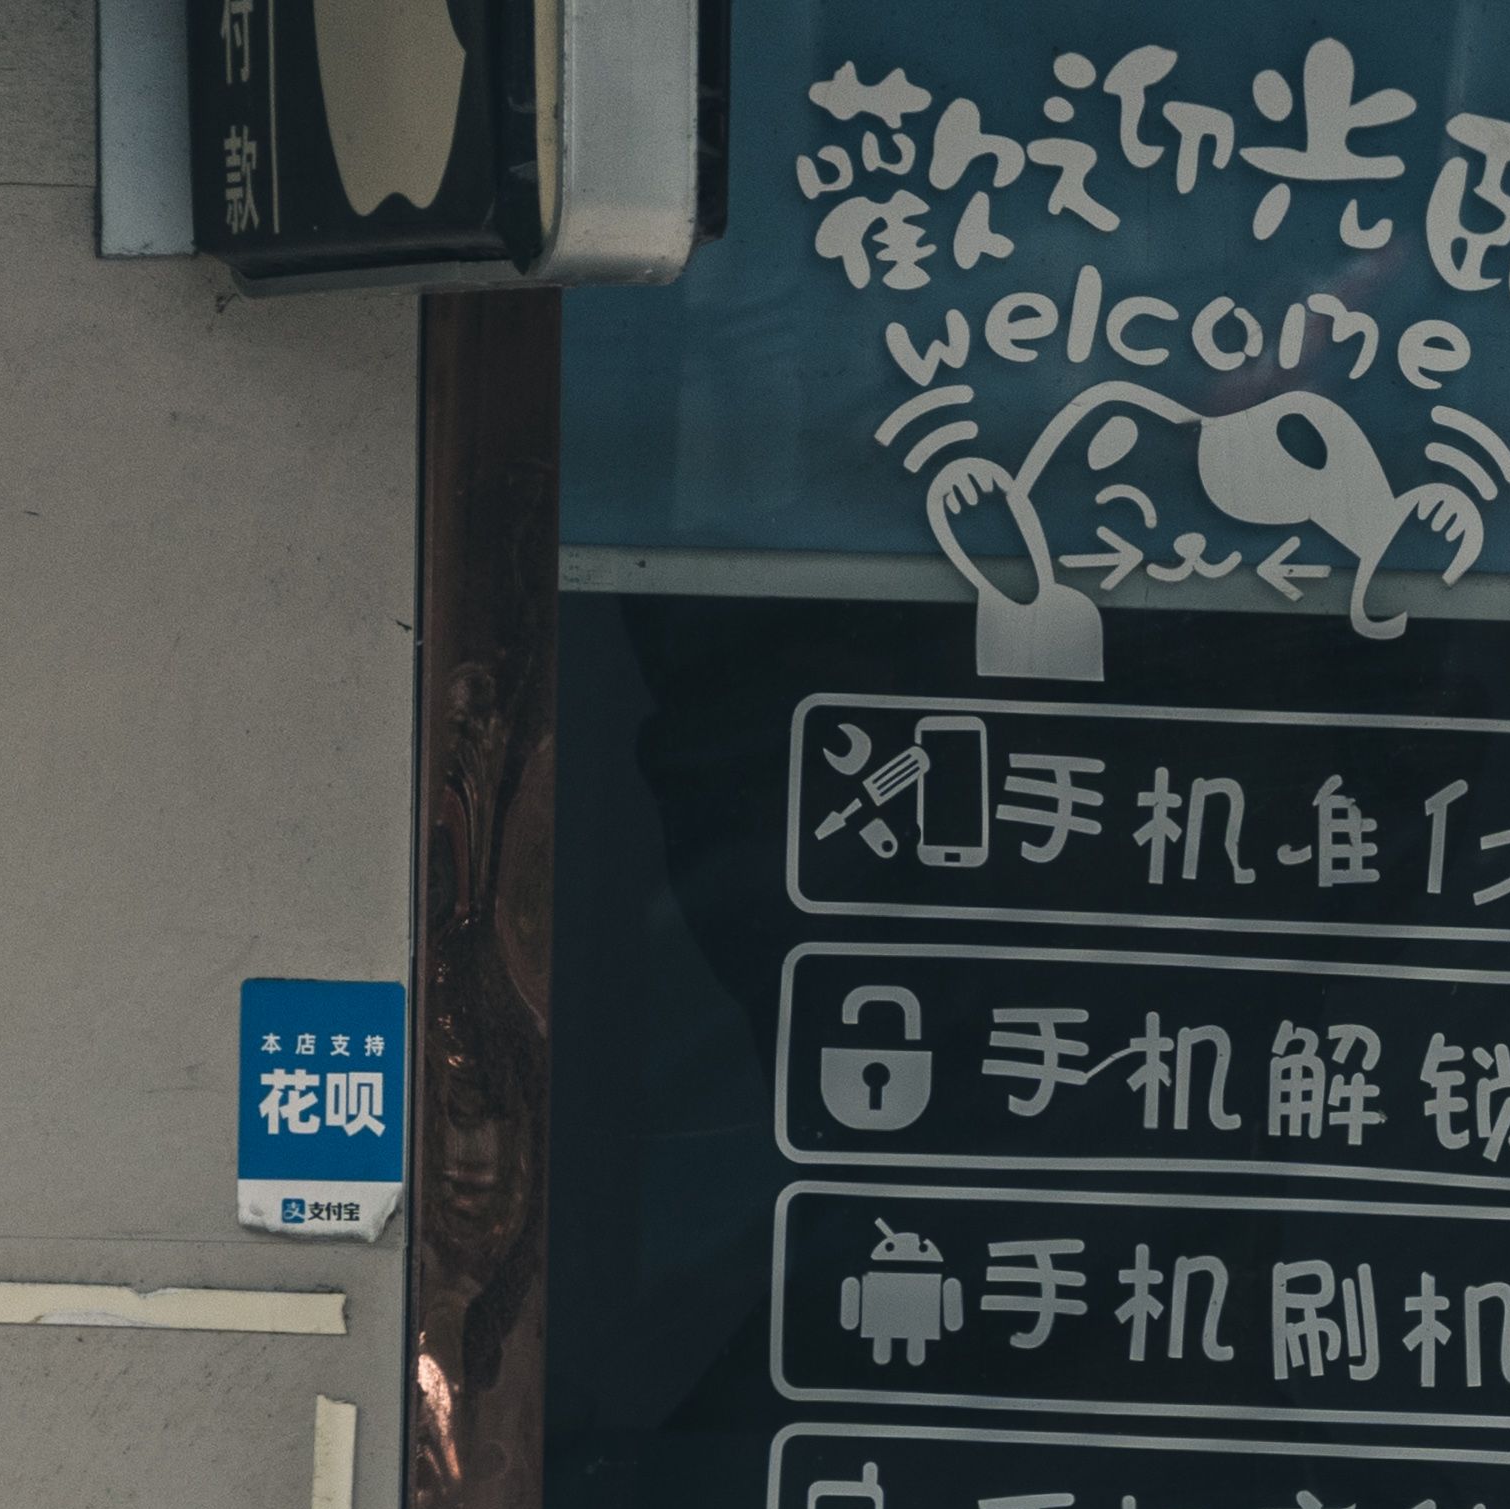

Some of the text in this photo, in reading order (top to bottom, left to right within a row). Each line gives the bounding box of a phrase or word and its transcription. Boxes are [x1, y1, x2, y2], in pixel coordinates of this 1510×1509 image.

[885, 264, 1472, 390] welcome
[260, 1032, 386, 1057] 本店支持
[259, 1068, 386, 1137] 花呗
[307, 1201, 360, 1222] 支付宝
